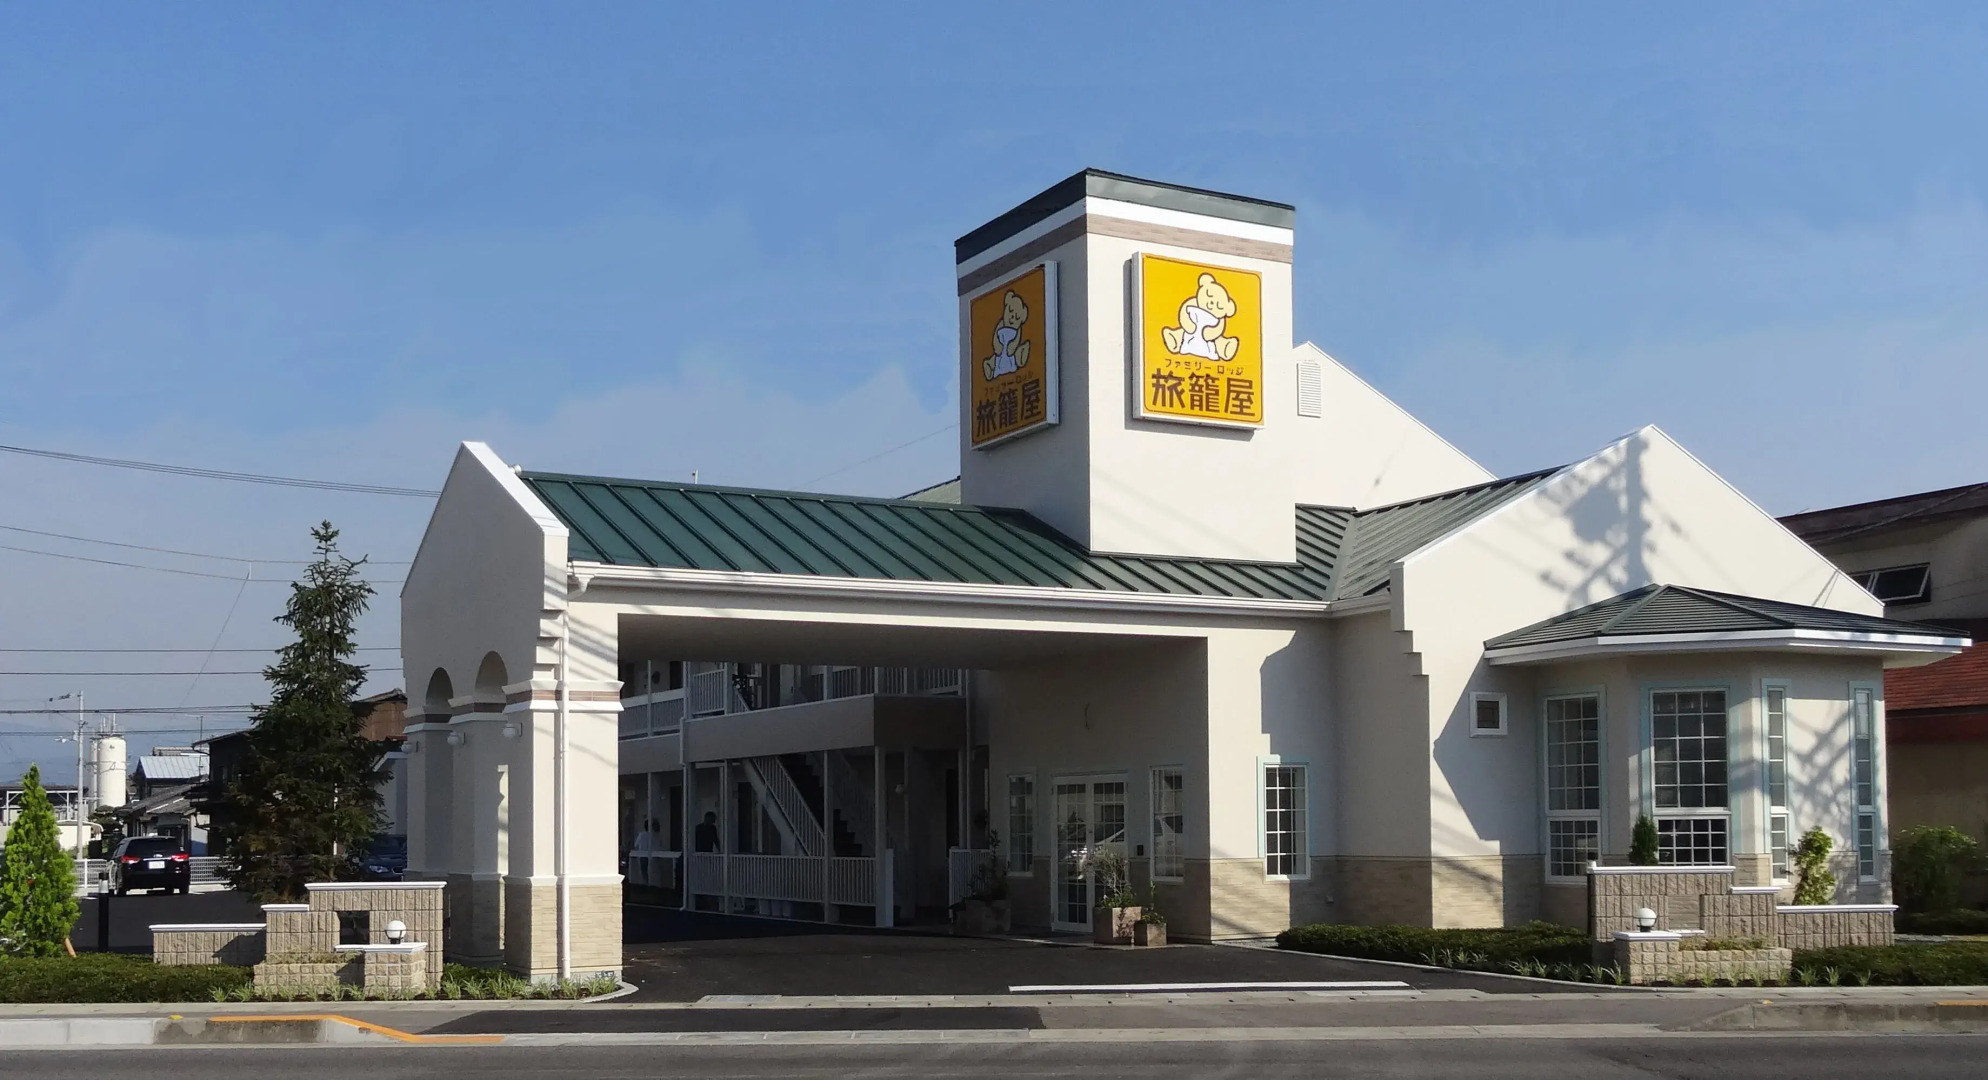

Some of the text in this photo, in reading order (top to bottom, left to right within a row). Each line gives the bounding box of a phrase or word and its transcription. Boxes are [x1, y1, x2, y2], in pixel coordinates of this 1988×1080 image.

[1165, 358, 1244, 375] ファミリーロッジ
[976, 378, 1041, 437] 旅籠屋
[1152, 368, 1255, 416] 旅籠屋
